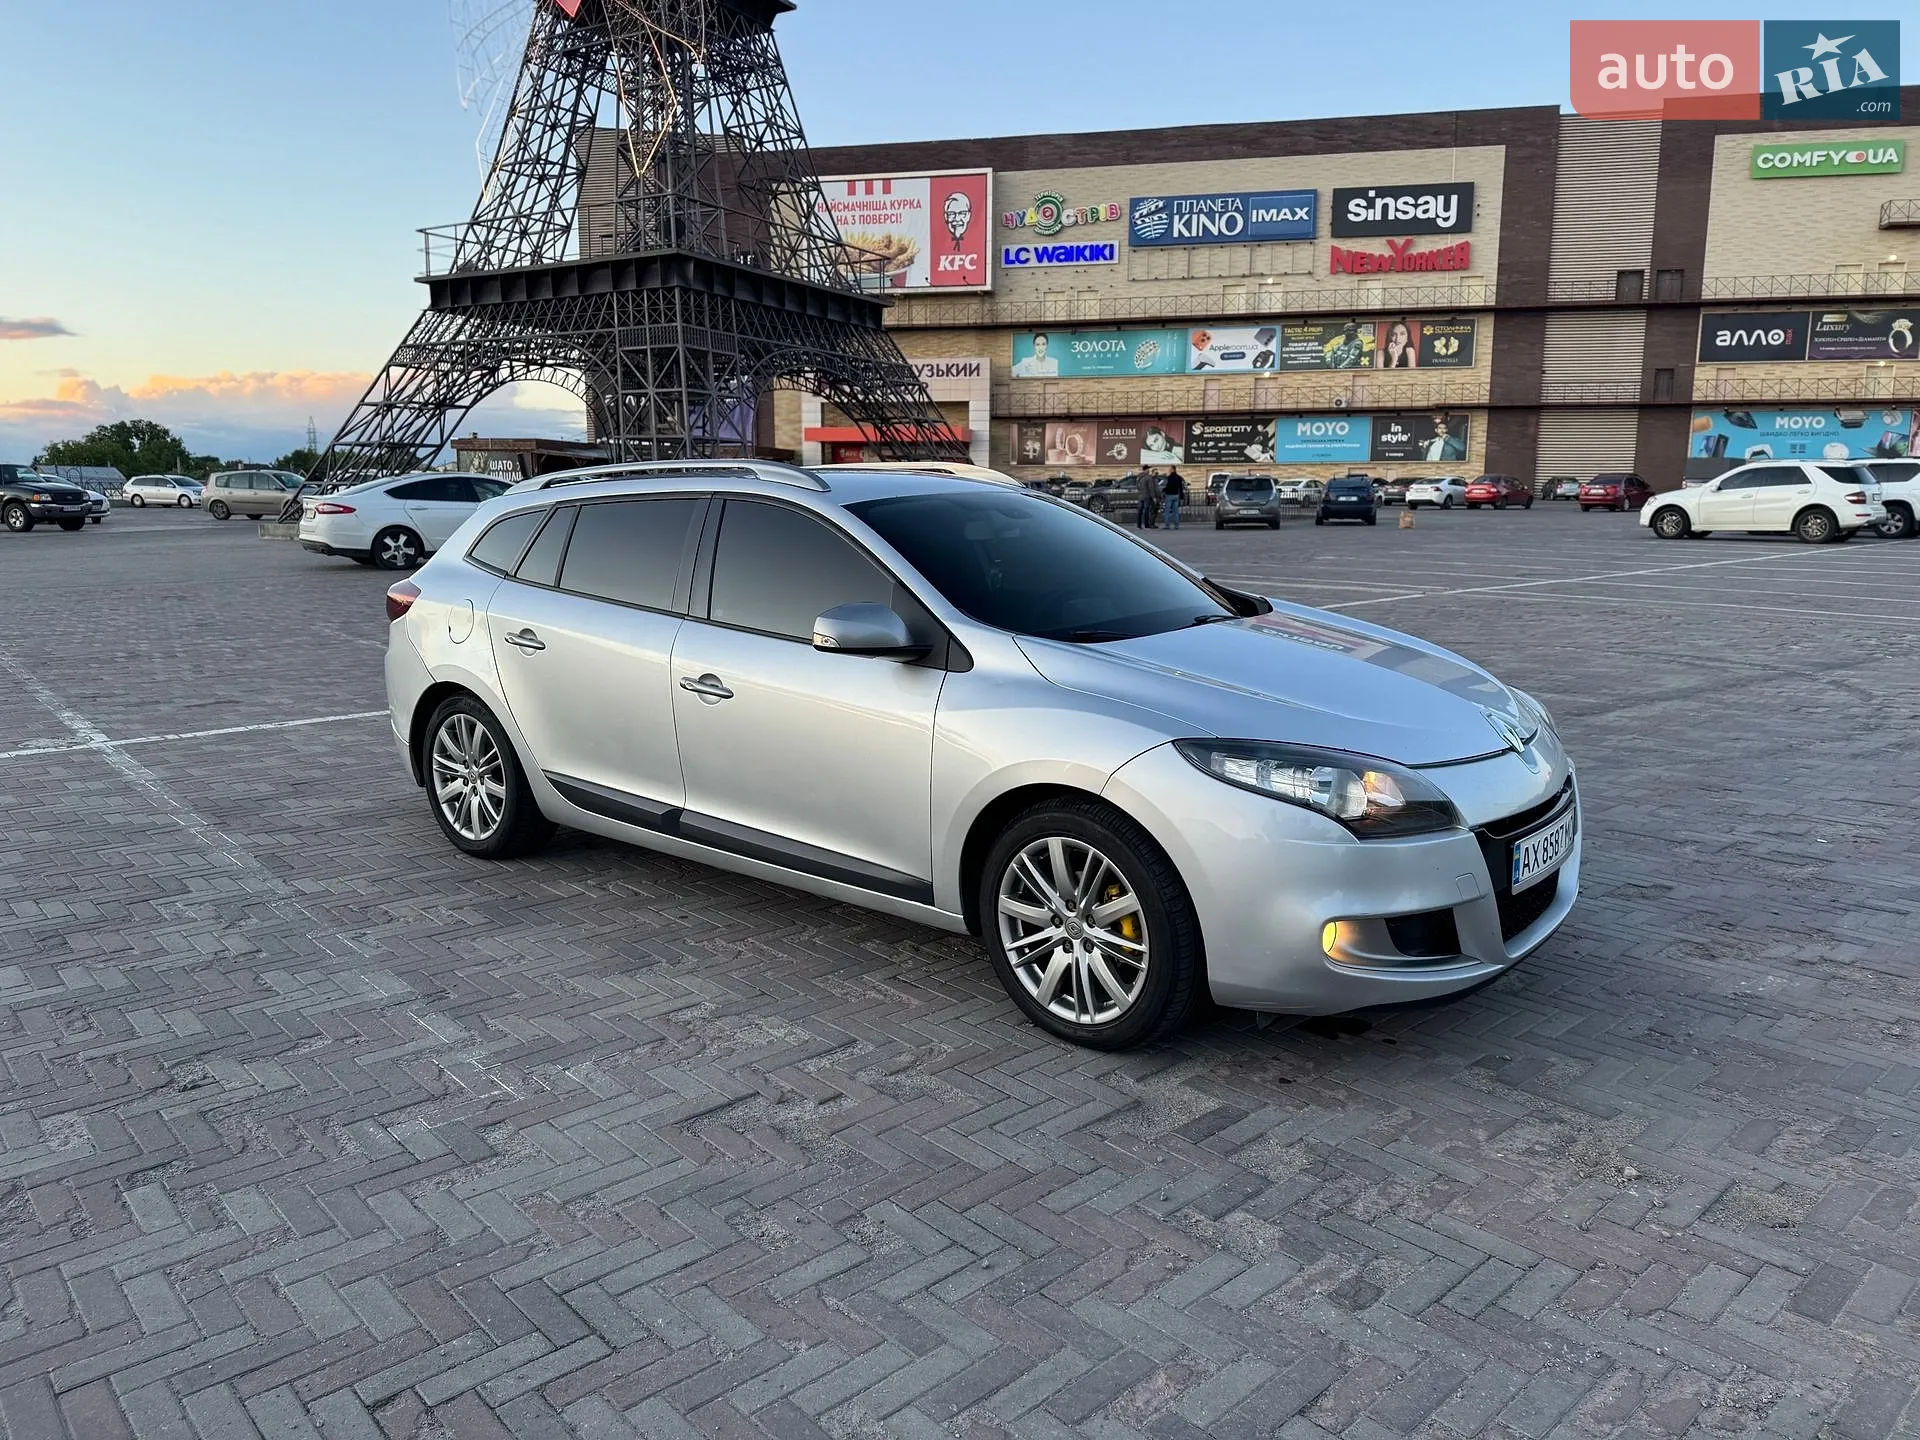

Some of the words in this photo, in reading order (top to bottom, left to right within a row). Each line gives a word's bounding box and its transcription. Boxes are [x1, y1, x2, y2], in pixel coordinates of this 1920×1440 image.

[817, 198, 888, 213] НАЙСМАЧНІША
[889, 198, 922, 211] КУРКА
[1347, 189, 1459, 228] sinsay
[837, 216, 853, 226] НА
[859, 212, 902, 226] ПОВЕРСІ!
[1251, 206, 1310, 223] IMAX
[938, 253, 978, 272] KFC
[1004, 247, 1030, 265] LC
[1815, 321, 1850, 333] Luxury
[1071, 339, 1126, 353] ЗОЛОТА
[1204, 425, 1252, 434] SPORTCITY
[1296, 421, 1349, 436] MOYO
[1391, 422, 1402, 433] in
[1775, 416, 1825, 429] MOYO
[1102, 428, 1136, 436] AURUM
